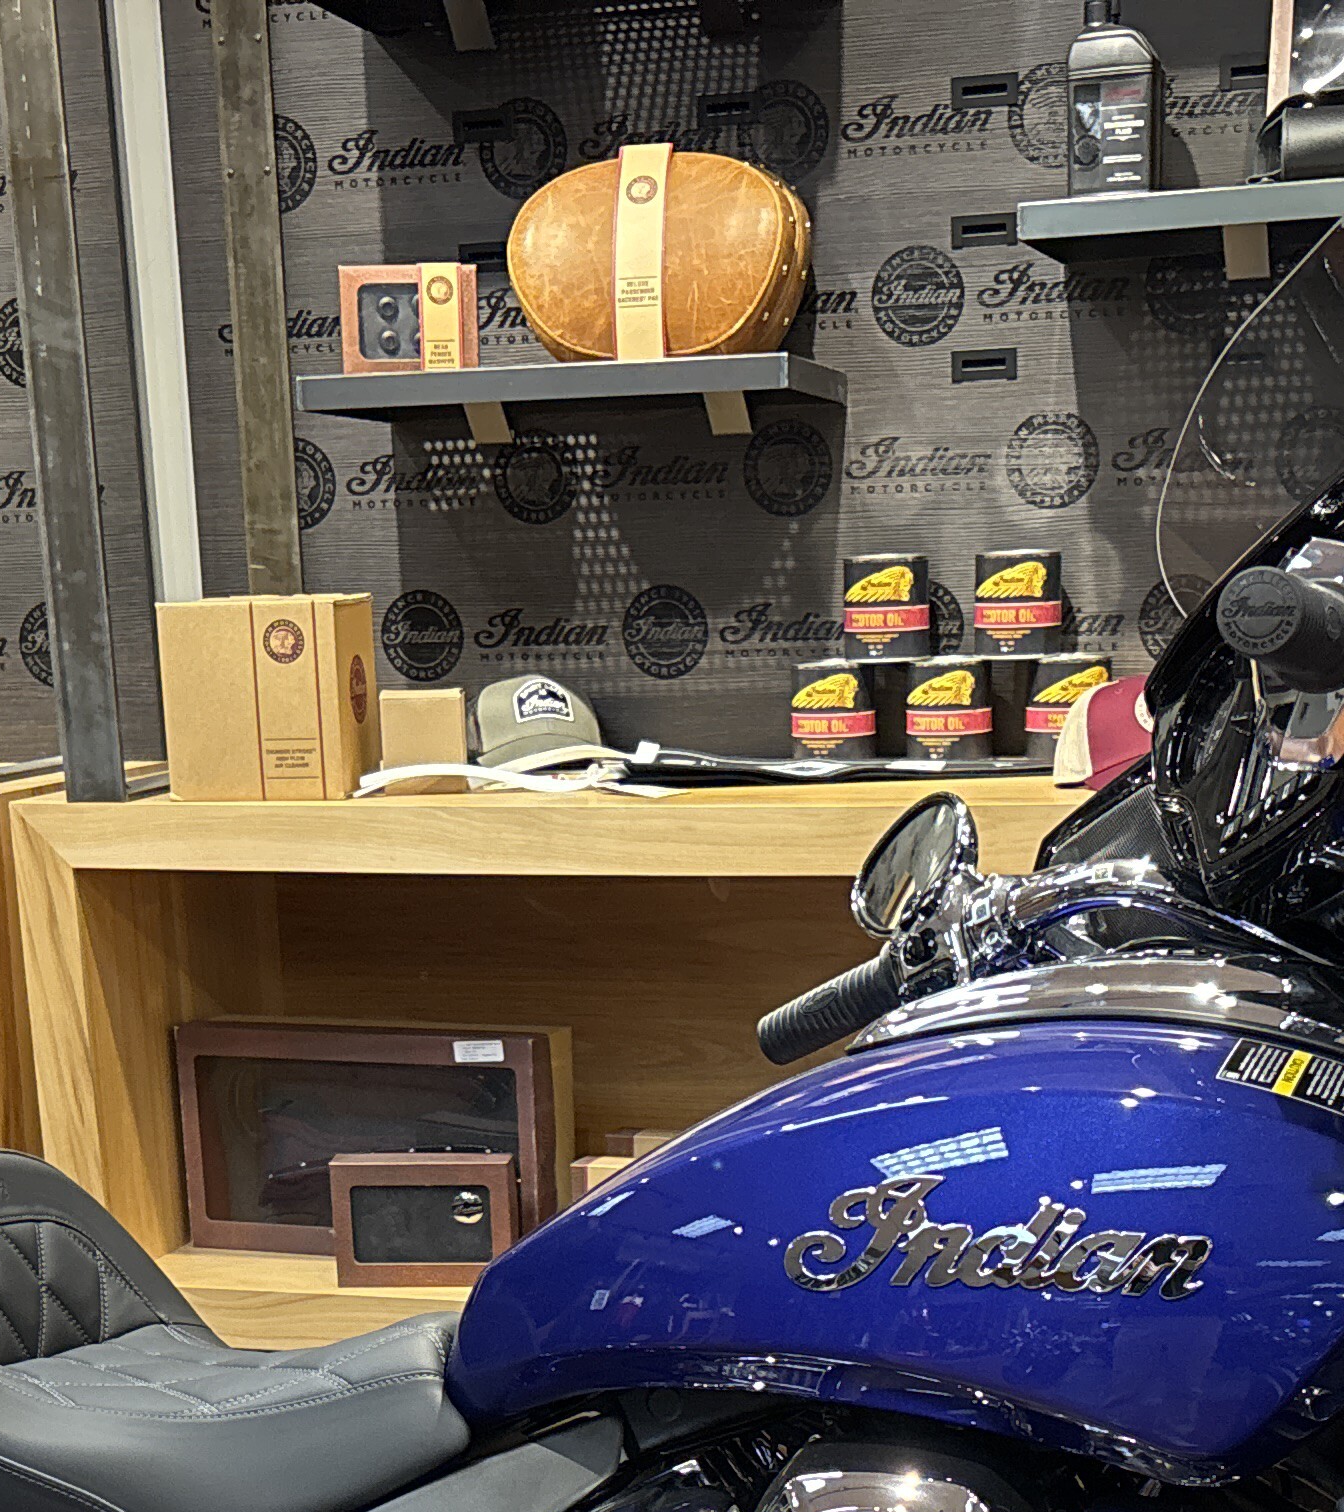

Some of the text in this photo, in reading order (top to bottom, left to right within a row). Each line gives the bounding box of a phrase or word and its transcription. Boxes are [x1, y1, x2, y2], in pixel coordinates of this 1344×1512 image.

[271, 11, 329, 23] CYCLE
[841, 95, 991, 143] Indian
[327, 130, 464, 175] Indian
[847, 140, 988, 158] MOTORCYCLE
[334, 173, 462, 190] MOTORCYCLE
[873, 280, 962, 306] Indian
[977, 262, 1130, 308] Indian
[845, 437, 992, 481] Indian
[850, 482, 987, 496] MOTORCYCLE
[1221, 596, 1298, 618] Indian
[383, 619, 459, 646] Indian
[474, 609, 608, 650] Indian
[624, 616, 705, 641] Indian
[725, 647, 844, 659] MOTORCYCL
[783, 1174, 1214, 1300] Indian
